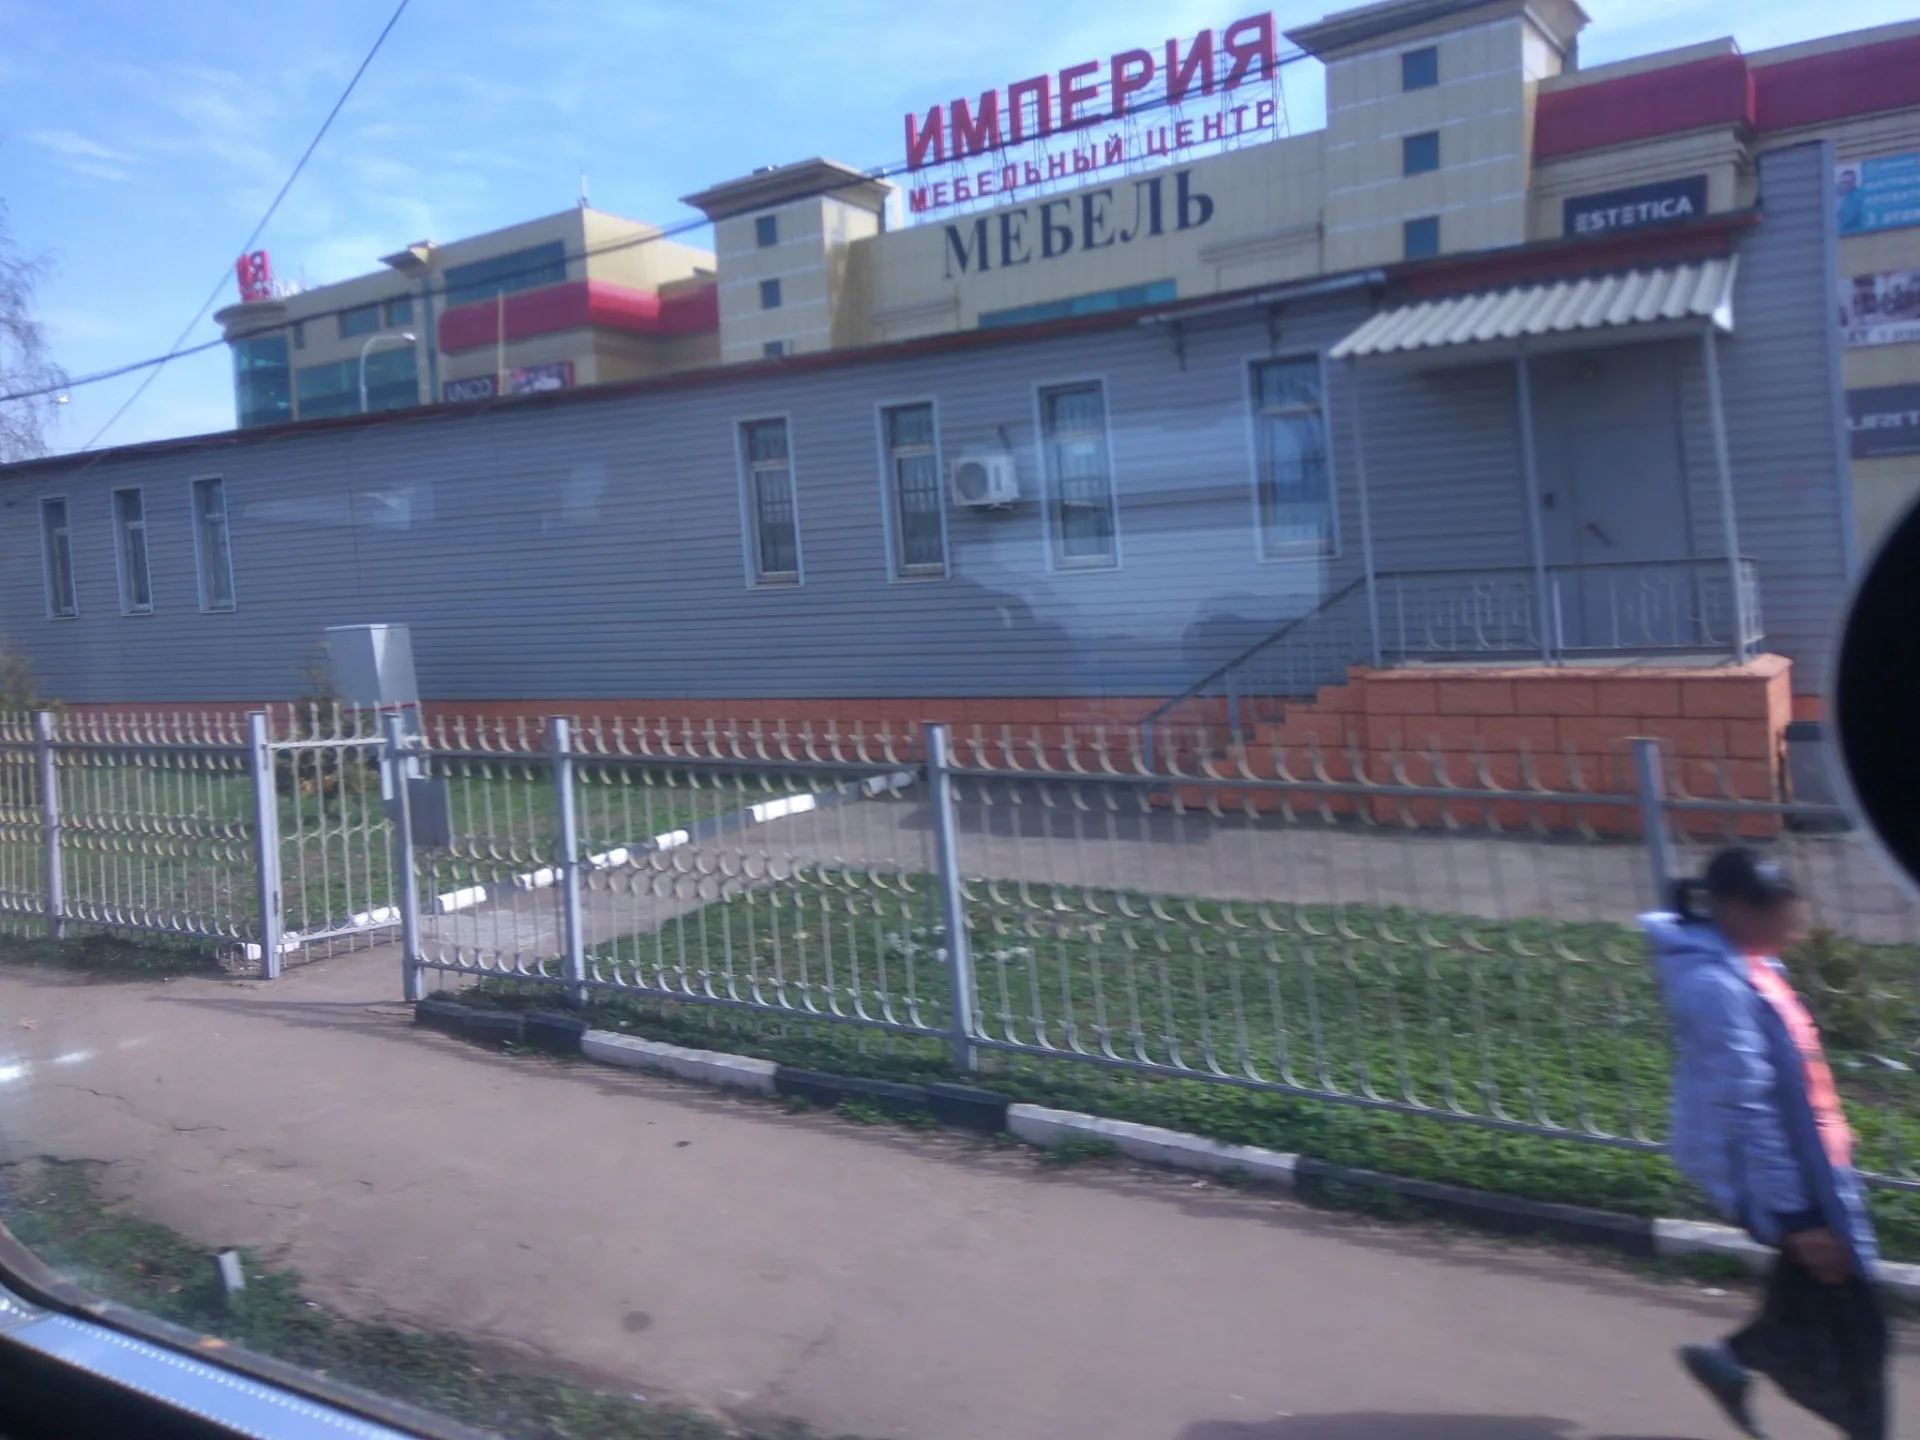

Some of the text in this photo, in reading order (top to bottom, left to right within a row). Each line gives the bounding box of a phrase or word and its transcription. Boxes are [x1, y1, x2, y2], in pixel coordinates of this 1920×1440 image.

[904, 10, 1278, 172] ИМПЕРИЯ
[908, 99, 1276, 213] МЕБЕЛЬНЫЙ ЦЕНТР
[942, 168, 1215, 279] МЕБЕЛЬ
[1574, 195, 1694, 233] ESTETICA
